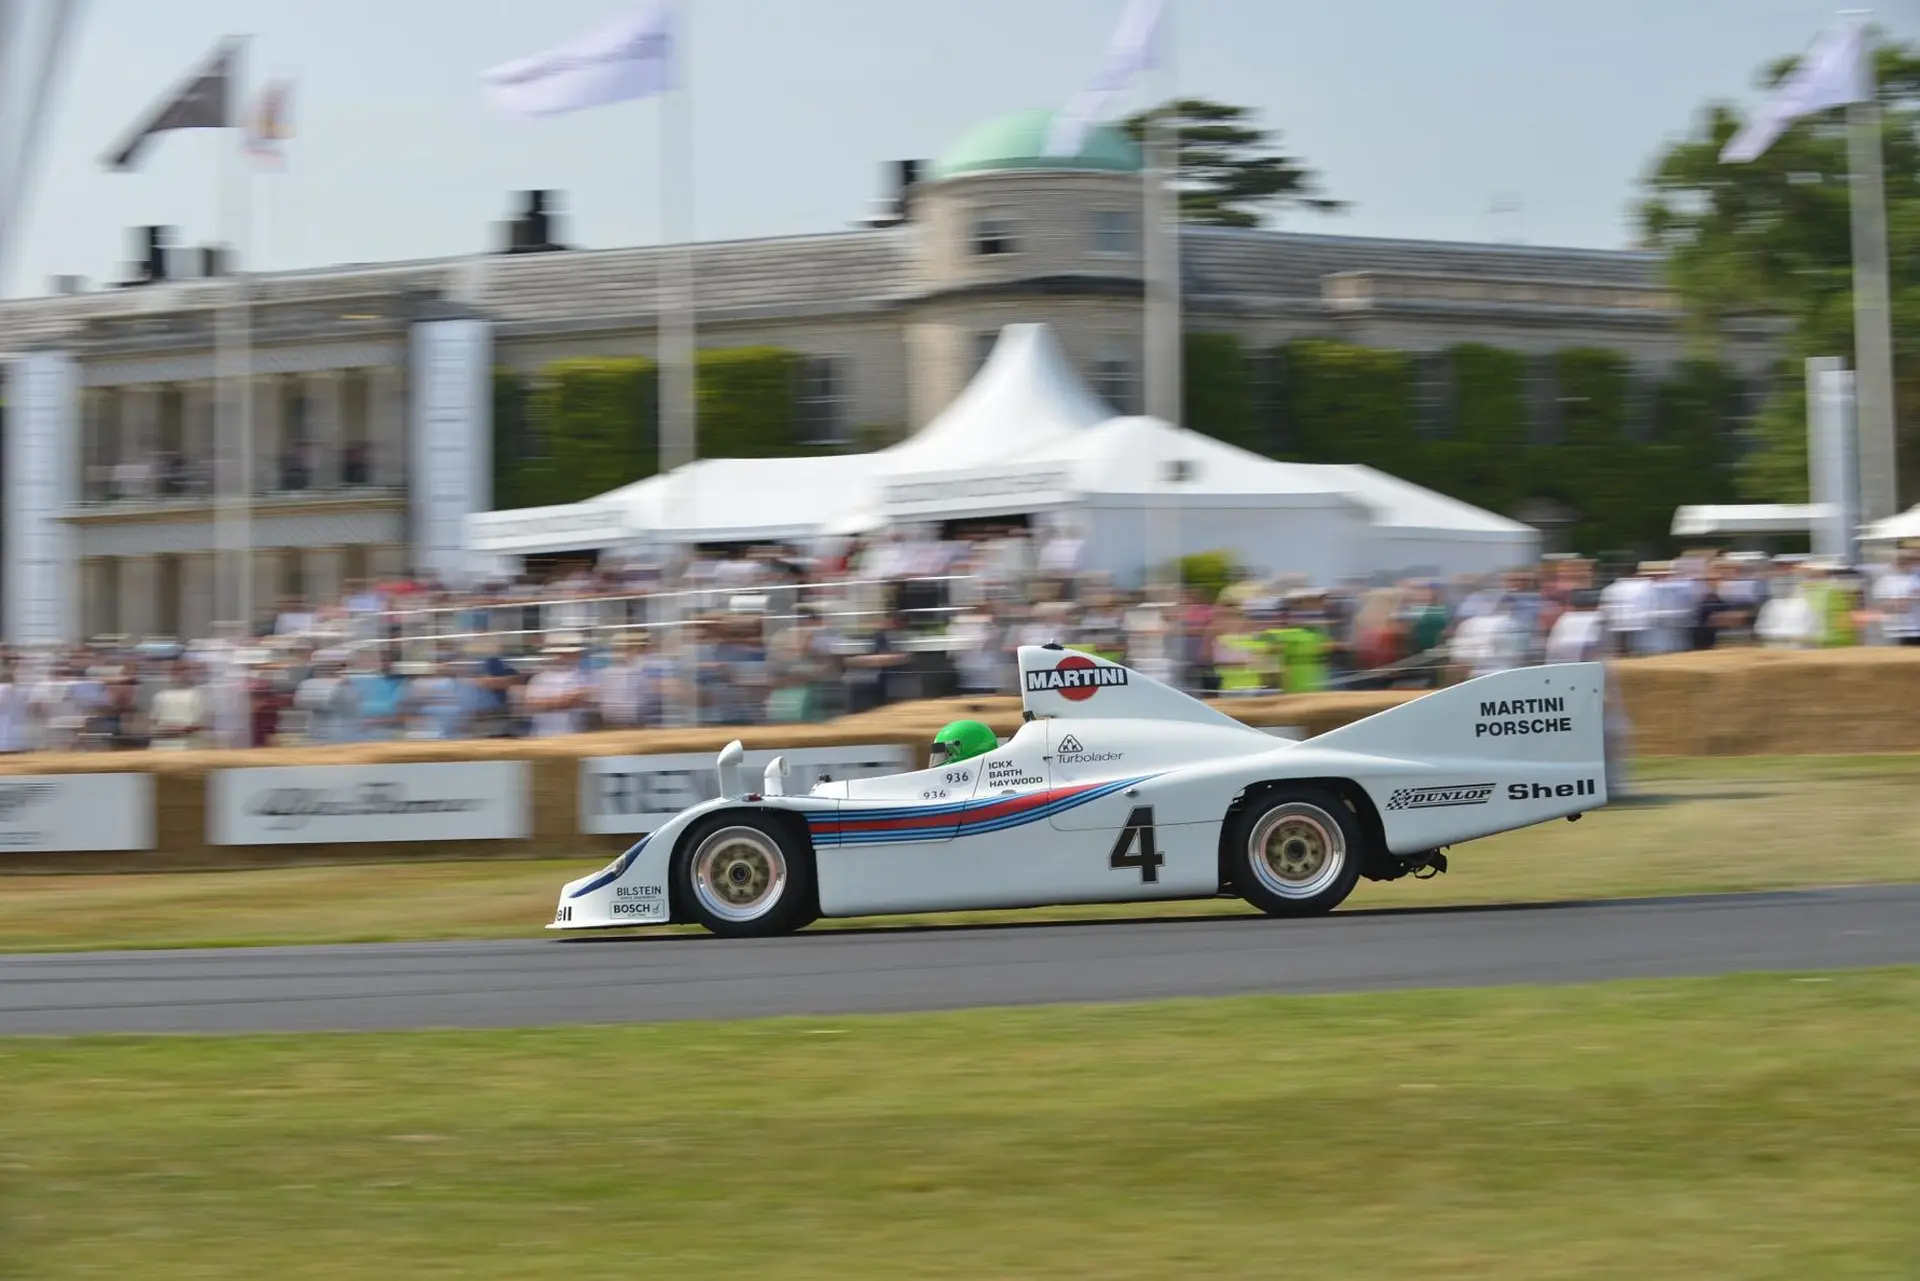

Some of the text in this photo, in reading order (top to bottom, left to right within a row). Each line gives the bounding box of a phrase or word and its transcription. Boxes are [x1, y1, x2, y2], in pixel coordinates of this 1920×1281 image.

[1028, 668, 1125, 689] MARTINI
[1480, 697, 1564, 716] MARTINI
[1475, 717, 1572, 737] PORSCHE
[1056, 751, 1125, 764] Turbolader
[988, 759, 1013, 770] ICKX
[945, 771, 970, 784] 936
[989, 768, 1023, 779] BARTH
[989, 776, 1044, 788] HAYWOOD
[923, 789, 947, 799] 936
[1411, 789, 1493, 802] DUNLOP
[1507, 779, 1596, 800] Shell
[1109, 805, 1165, 883] 4
[616, 885, 662, 896] BILSTEIN
[613, 903, 651, 914] BOSCH
